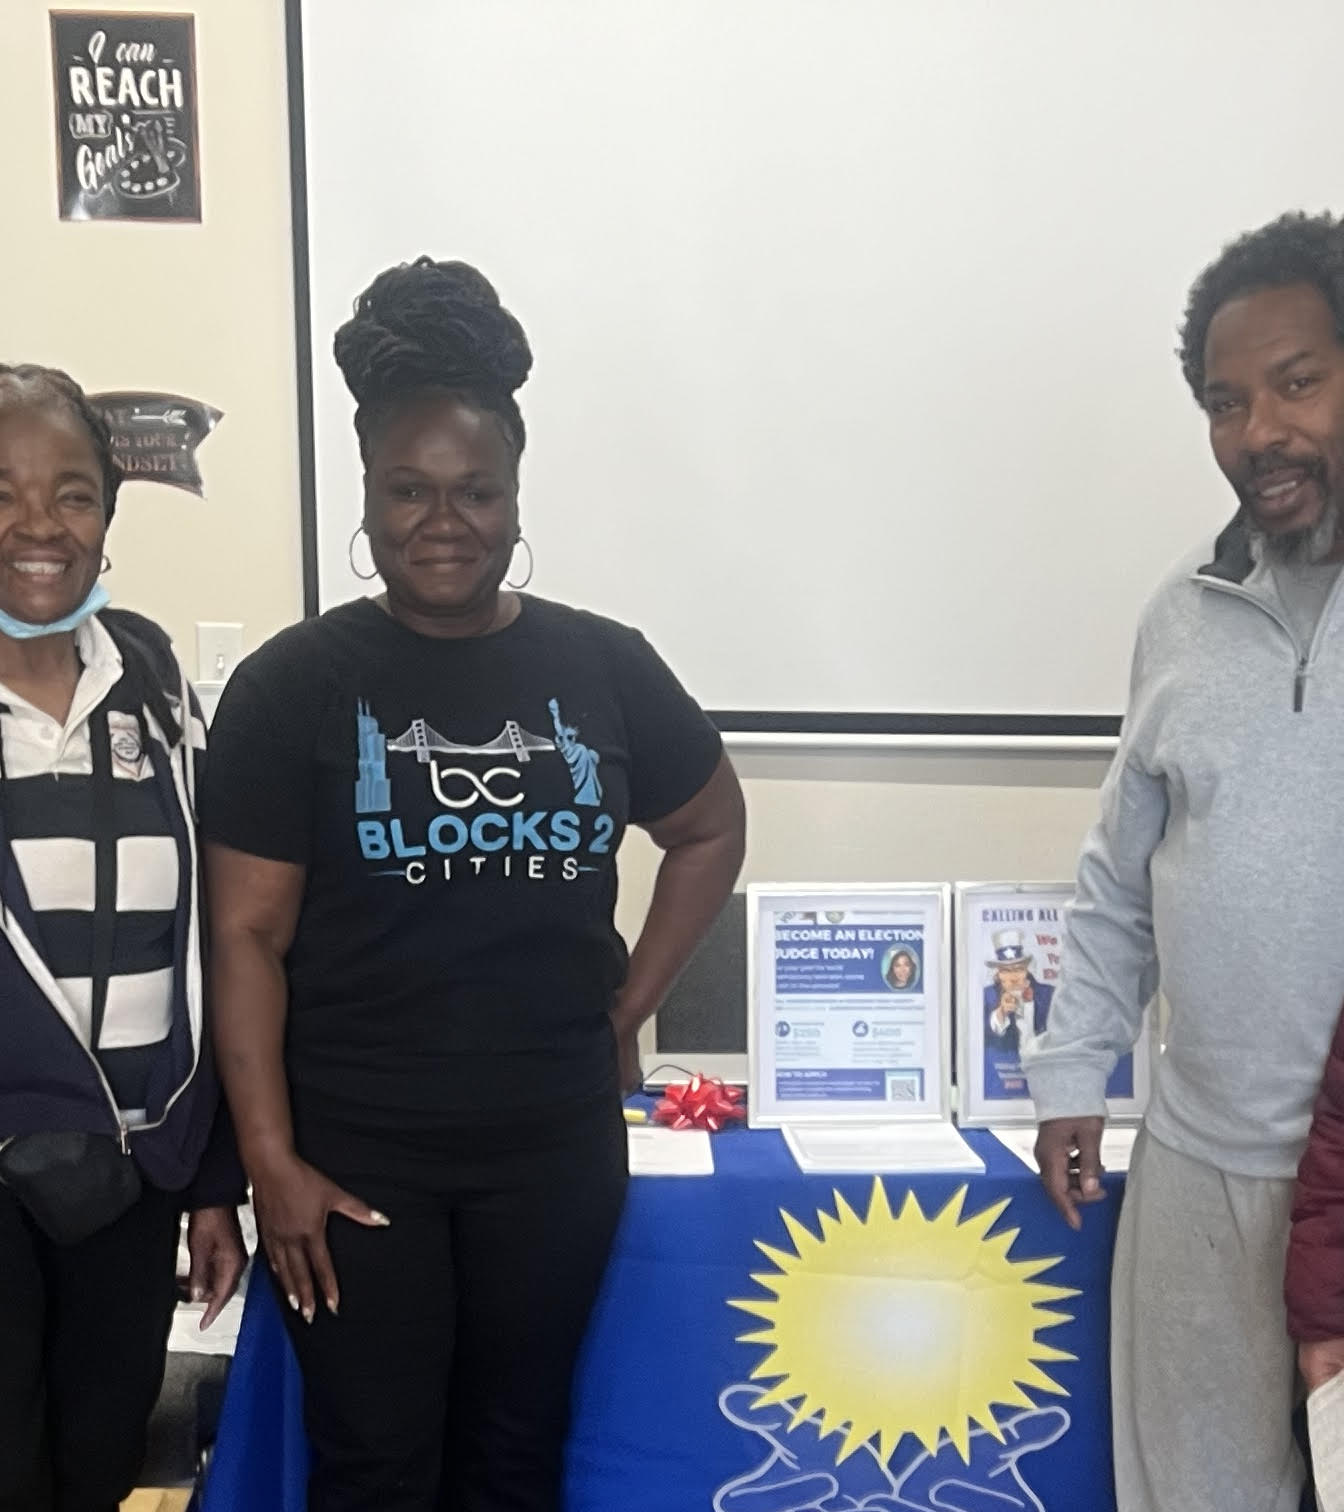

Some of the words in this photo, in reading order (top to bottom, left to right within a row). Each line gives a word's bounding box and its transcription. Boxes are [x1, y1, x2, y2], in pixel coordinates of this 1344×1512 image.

[88, 30, 106, 63] I
[115, 42, 156, 62] can
[69, 66, 184, 108] REACH
[75, 113, 108, 135] MY
[75, 126, 134, 190] Goals
[357, 810, 582, 860] BLOCKS
[588, 813, 614, 854] 2
[405, 855, 579, 884] CITIES
[982, 908, 1034, 922] CALLING
[1038, 908, 1058, 922] ALL
[776, 929, 831, 941] BECOME
[834, 930, 856, 941] AN
[858, 929, 924, 942] ELECTION
[776, 947, 819, 960] JUDGE
[821, 947, 875, 960] TODAY!
